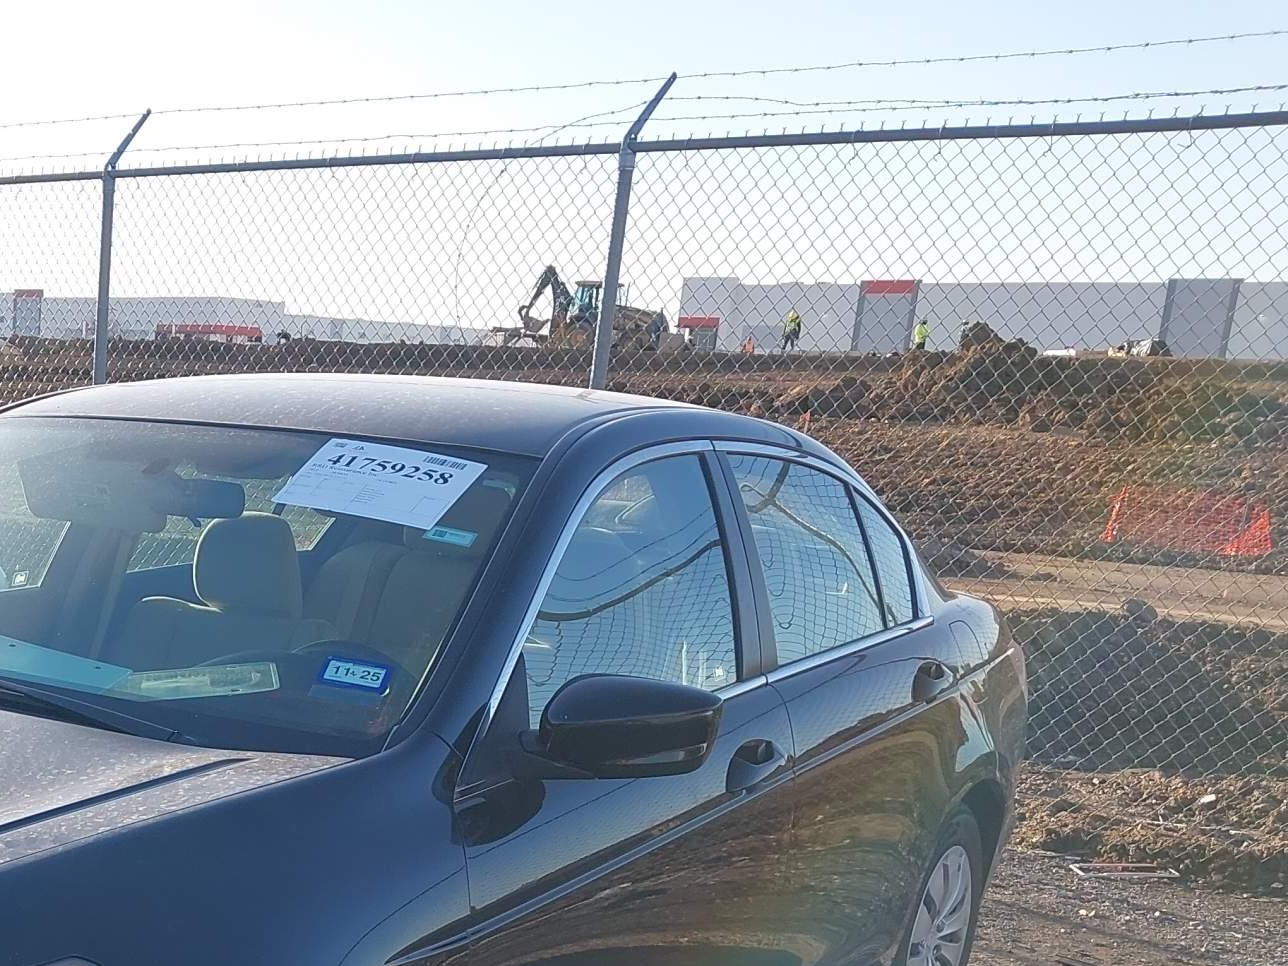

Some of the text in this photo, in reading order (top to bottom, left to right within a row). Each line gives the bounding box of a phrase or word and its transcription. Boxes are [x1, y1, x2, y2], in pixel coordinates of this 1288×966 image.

[327, 453, 454, 485] 41759258
[332, 665, 382, 682] 11 25
